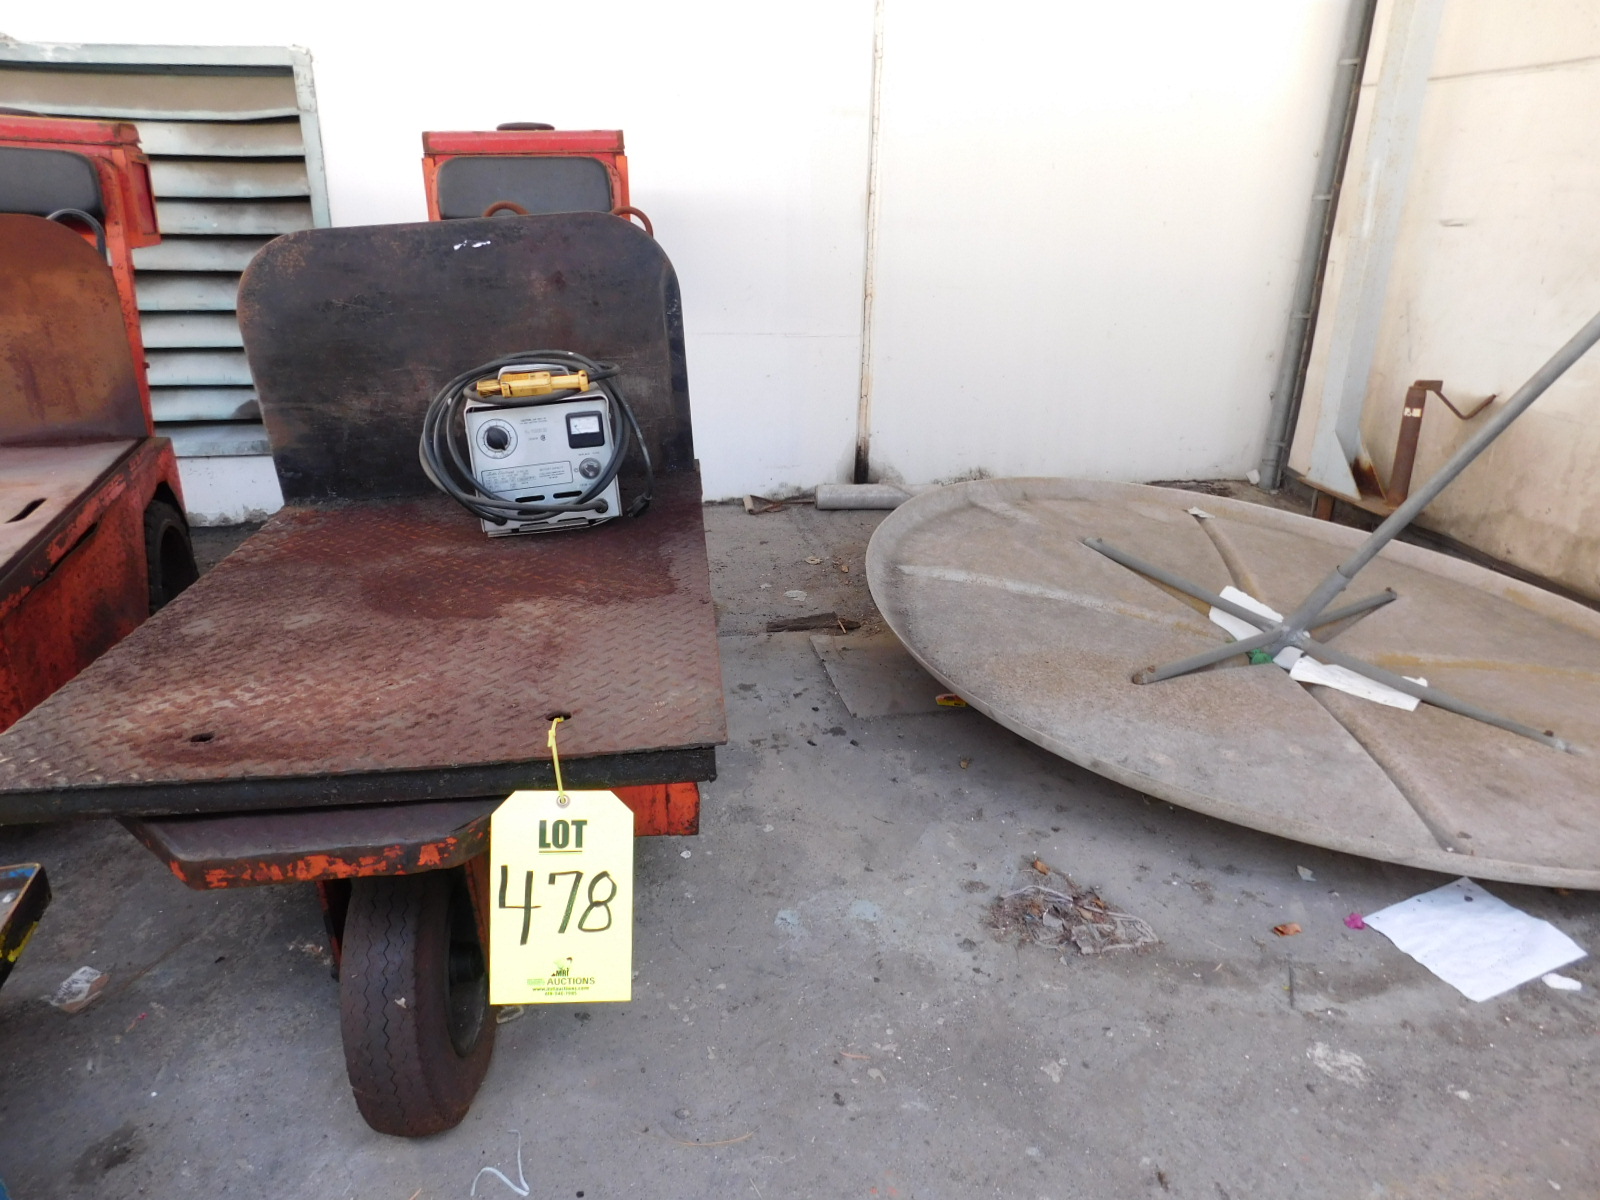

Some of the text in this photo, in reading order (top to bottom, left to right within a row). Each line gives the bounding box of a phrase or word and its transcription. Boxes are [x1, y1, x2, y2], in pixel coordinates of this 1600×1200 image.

[538, 819, 588, 849] LOT
[498, 864, 617, 946] 478
[546, 976, 596, 986] AUCTIONS
